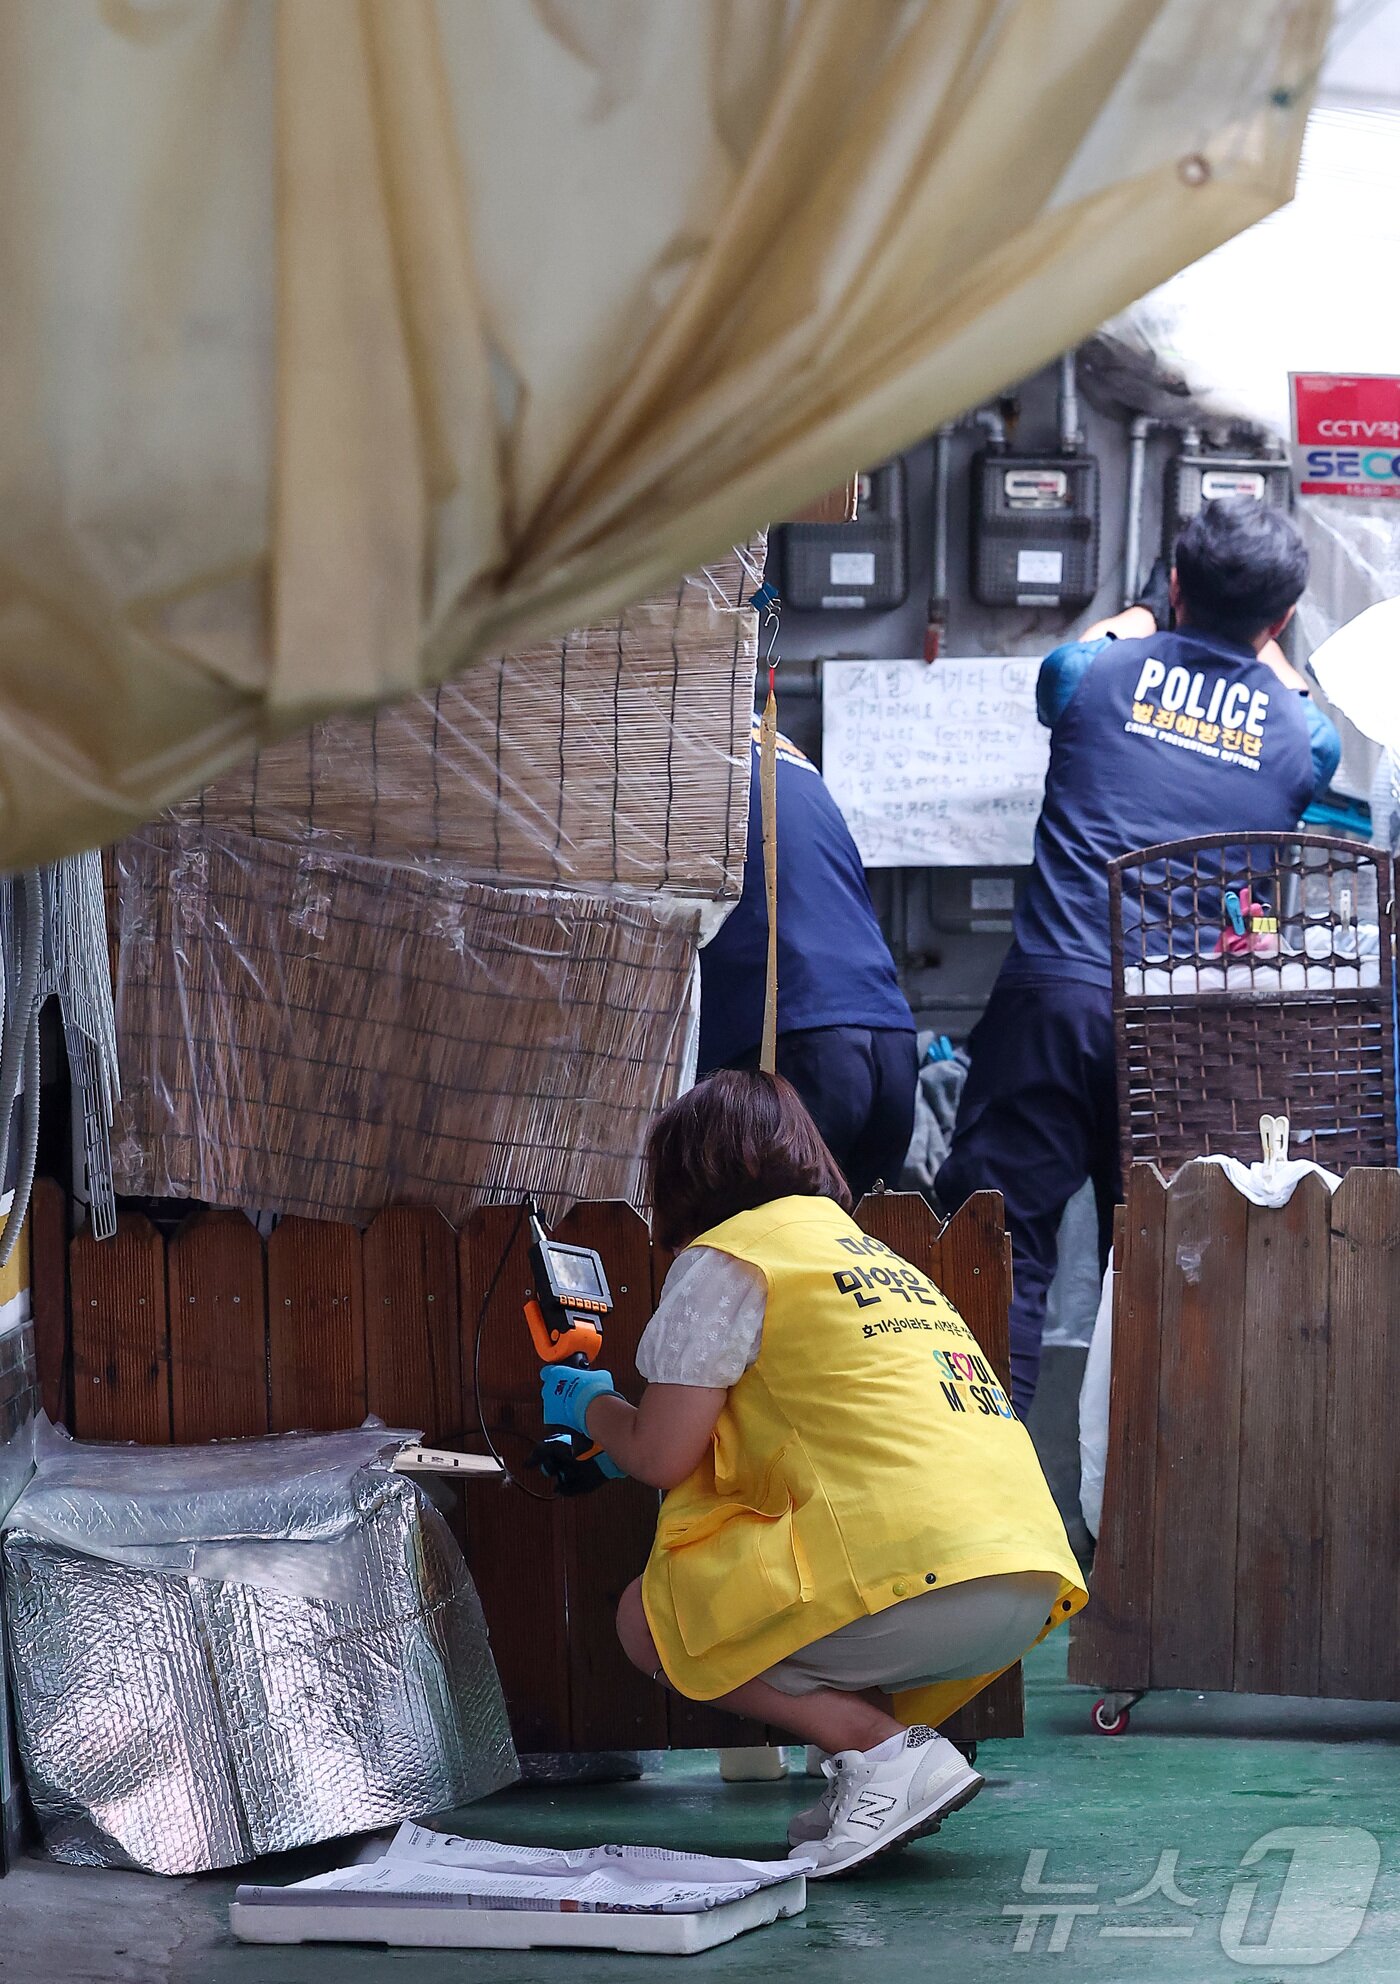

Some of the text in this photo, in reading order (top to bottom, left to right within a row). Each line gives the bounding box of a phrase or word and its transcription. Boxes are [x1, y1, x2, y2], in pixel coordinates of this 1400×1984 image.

[1133, 657, 1269, 737] POLICE
[832, 1266, 937, 1309] 만약은
[862, 1317, 932, 1339] 호기심이라도
